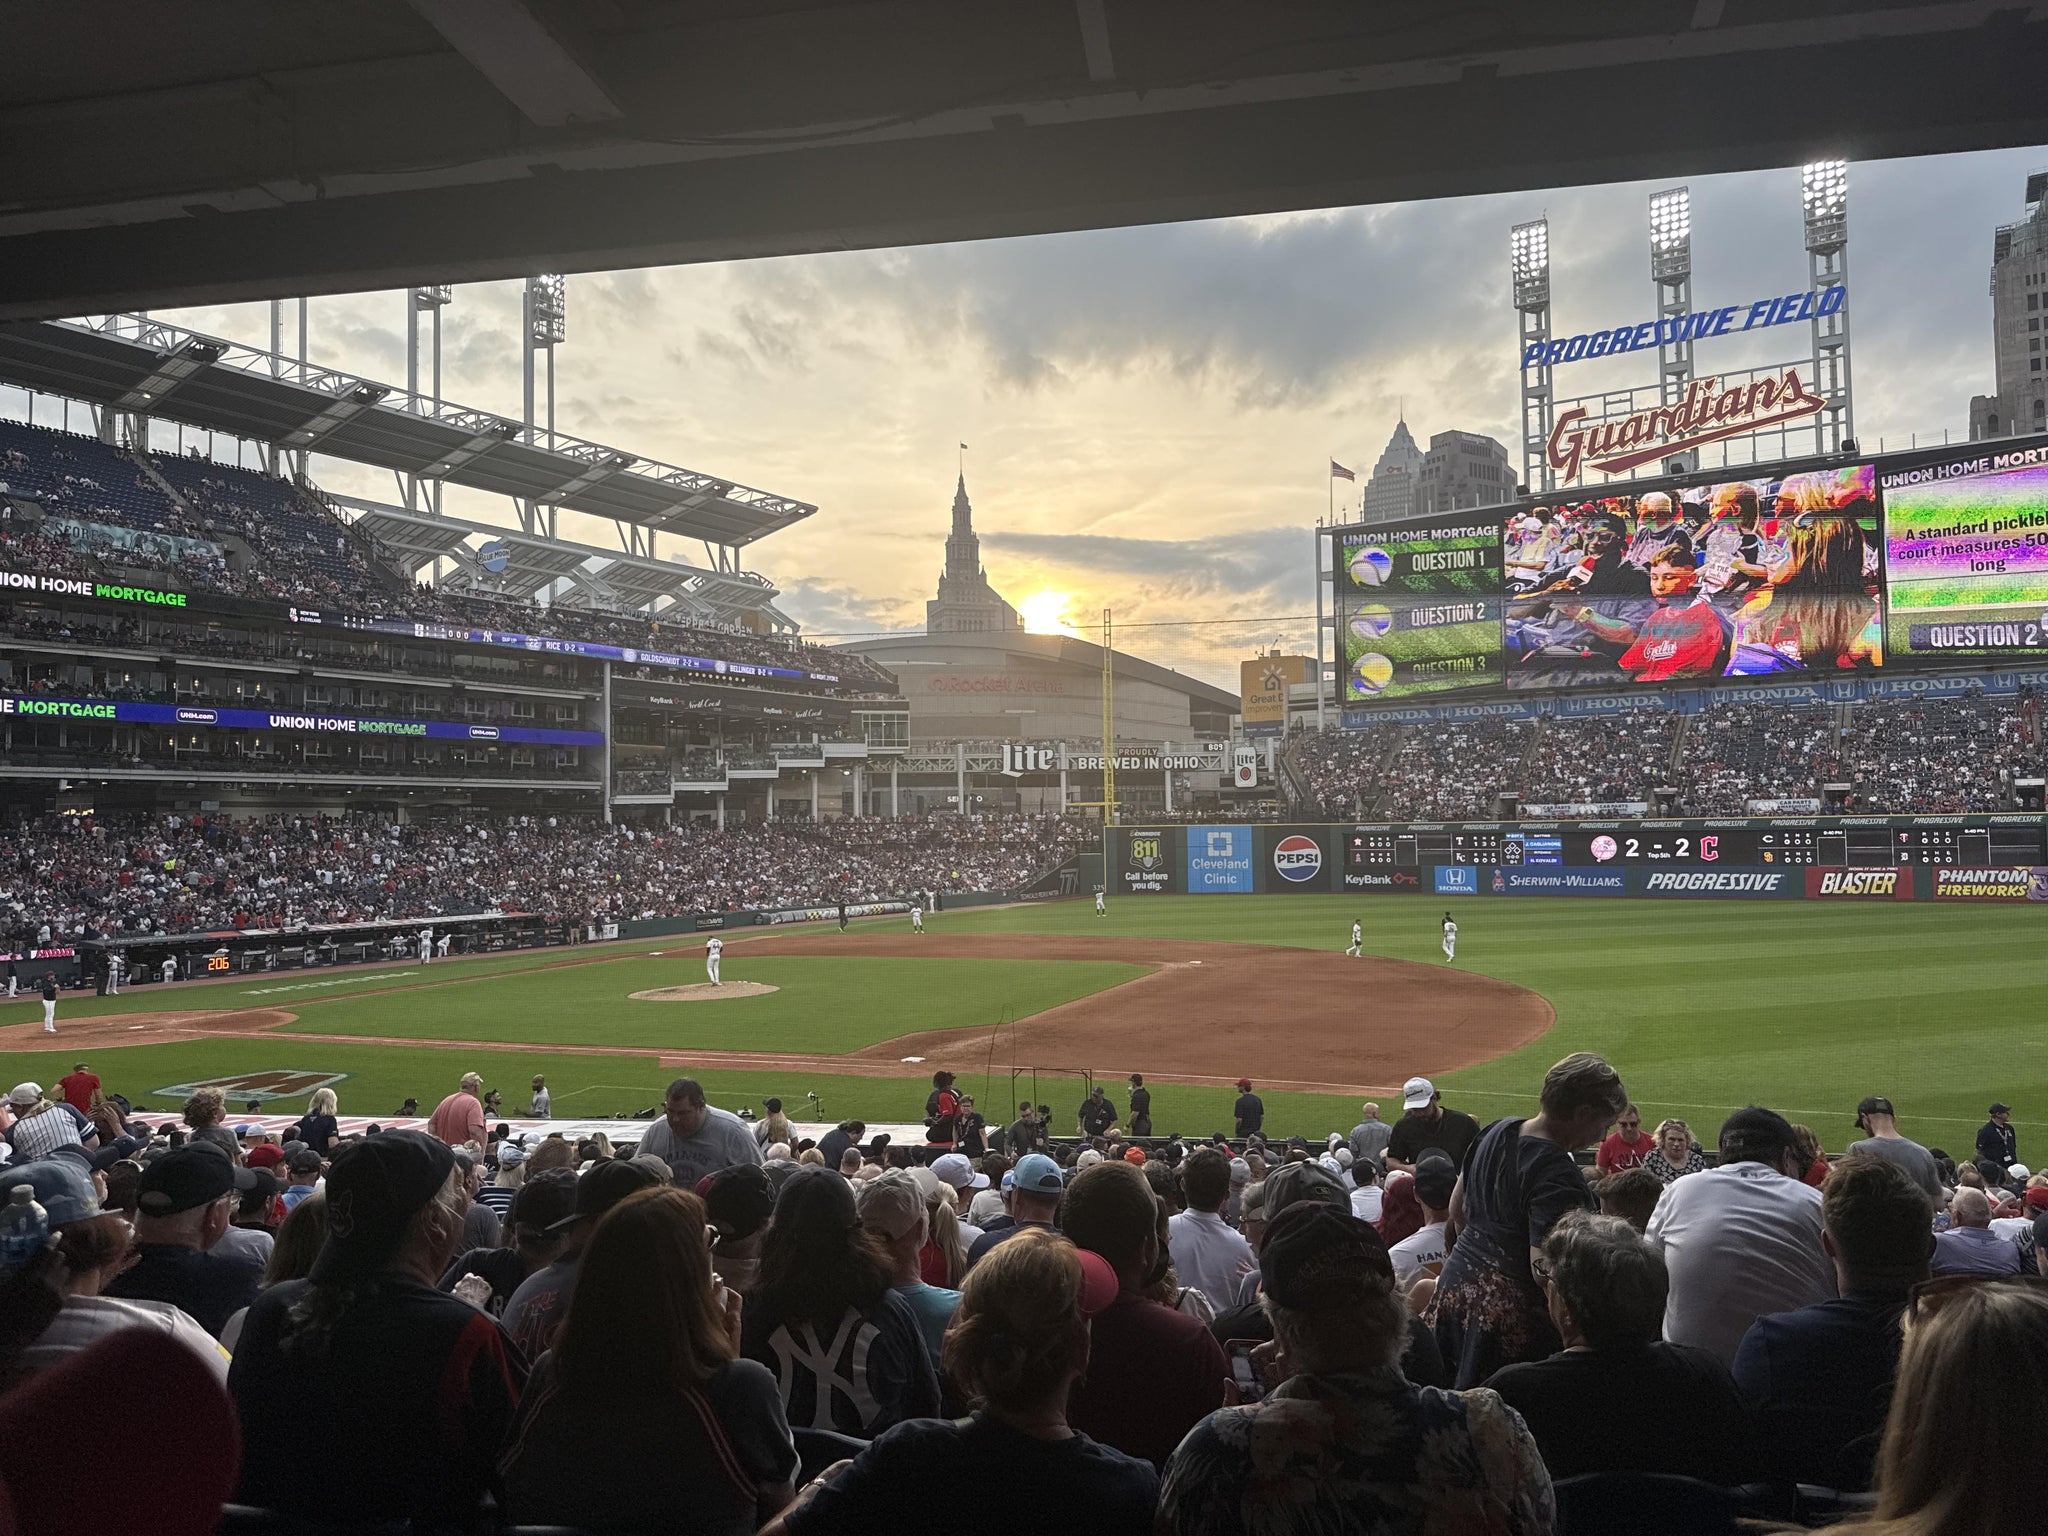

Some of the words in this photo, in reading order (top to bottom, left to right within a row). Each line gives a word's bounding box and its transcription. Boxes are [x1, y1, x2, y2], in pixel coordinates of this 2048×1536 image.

[1520, 306, 1738, 370] PROGRESSIVE
[1743, 286, 1846, 331] FIELD
[1546, 367, 1827, 487] Guardians
[1882, 468, 1933, 488] UNION
[1938, 458, 1989, 478] HOME
[1343, 532, 1387, 546] UNION
[1387, 530, 1428, 542] HOME
[1431, 526, 1499, 540] MORTGAGE
[1906, 529, 1916, 542] A
[1918, 519, 1988, 540] standard
[1898, 546, 1937, 560] court
[1941, 538, 2020, 556] measures
[1412, 550, 1475, 572] QUESTION
[1478, 550, 1485, 566] 1
[1970, 558, 2006, 572] long
[41, 578, 93, 596] HOME
[96, 584, 187, 606] MORTGAGE
[1411, 604, 1474, 626] QUESTION
[1477, 602, 1485, 620] 2
[718, 622, 752, 636] GARDEN
[1930, 624, 2020, 648] QUESTION
[2024, 622, 2040, 646] 2
[546, 641, 561, 650] RICE
[564, 644, 576, 652] 0-2
[640, 654, 680, 666] GOLDSCHMIDT
[730, 664, 756, 675] BELLINGER
[1412, 656, 1474, 680] QUESTION
[950, 676, 1010, 692] Rocket
[1016, 678, 1064, 694] Arena
[1890, 676, 1986, 693] HONDA
[650, 696, 673, 705] KeyBank
[1250, 695, 1276, 704] Great
[1732, 686, 1819, 701] HONDA
[18, 700, 116, 718] MORTGAGE
[1454, 704, 1528, 717] HONDA
[1585, 696, 1665, 709] HONDA
[1365, 709, 1432, 722] HONDA
[270, 716, 315, 730] UNION
[318, 718, 356, 732] HOME
[358, 722, 426, 736] MORTGAGE
[1118, 748, 1158, 756] PROUDLY
[1236, 754, 1254, 766] Lite
[1000, 744, 1054, 778] Lite
[1078, 758, 1140, 770] BREWED
[1144, 758, 1159, 770] IN
[1163, 756, 1199, 770] OHIO
[1132, 840, 1158, 858] 811
[1626, 838, 1640, 857] 2
[1675, 838, 1690, 857] 2
[1700, 836, 1719, 862] C
[1192, 858, 1248, 870] Cleveland
[1278, 854, 1318, 864] PEPSI
[1126, 872, 1140, 880] Call
[1142, 872, 1168, 880] before
[1204, 873, 1237, 884] Clinic
[1346, 874, 1392, 886] KeyBank
[1646, 873, 1783, 890] PROGRESSIVE
[1820, 872, 1897, 895] BLASTER
[1938, 870, 2028, 883] PHANTOM
[1132, 882, 1146, 890] you
[1147, 882, 1162, 890] dig.
[1936, 884, 2028, 897] FIREWORKS
[208, 956, 230, 970] 206
[768, 1305, 882, 1431] NY
